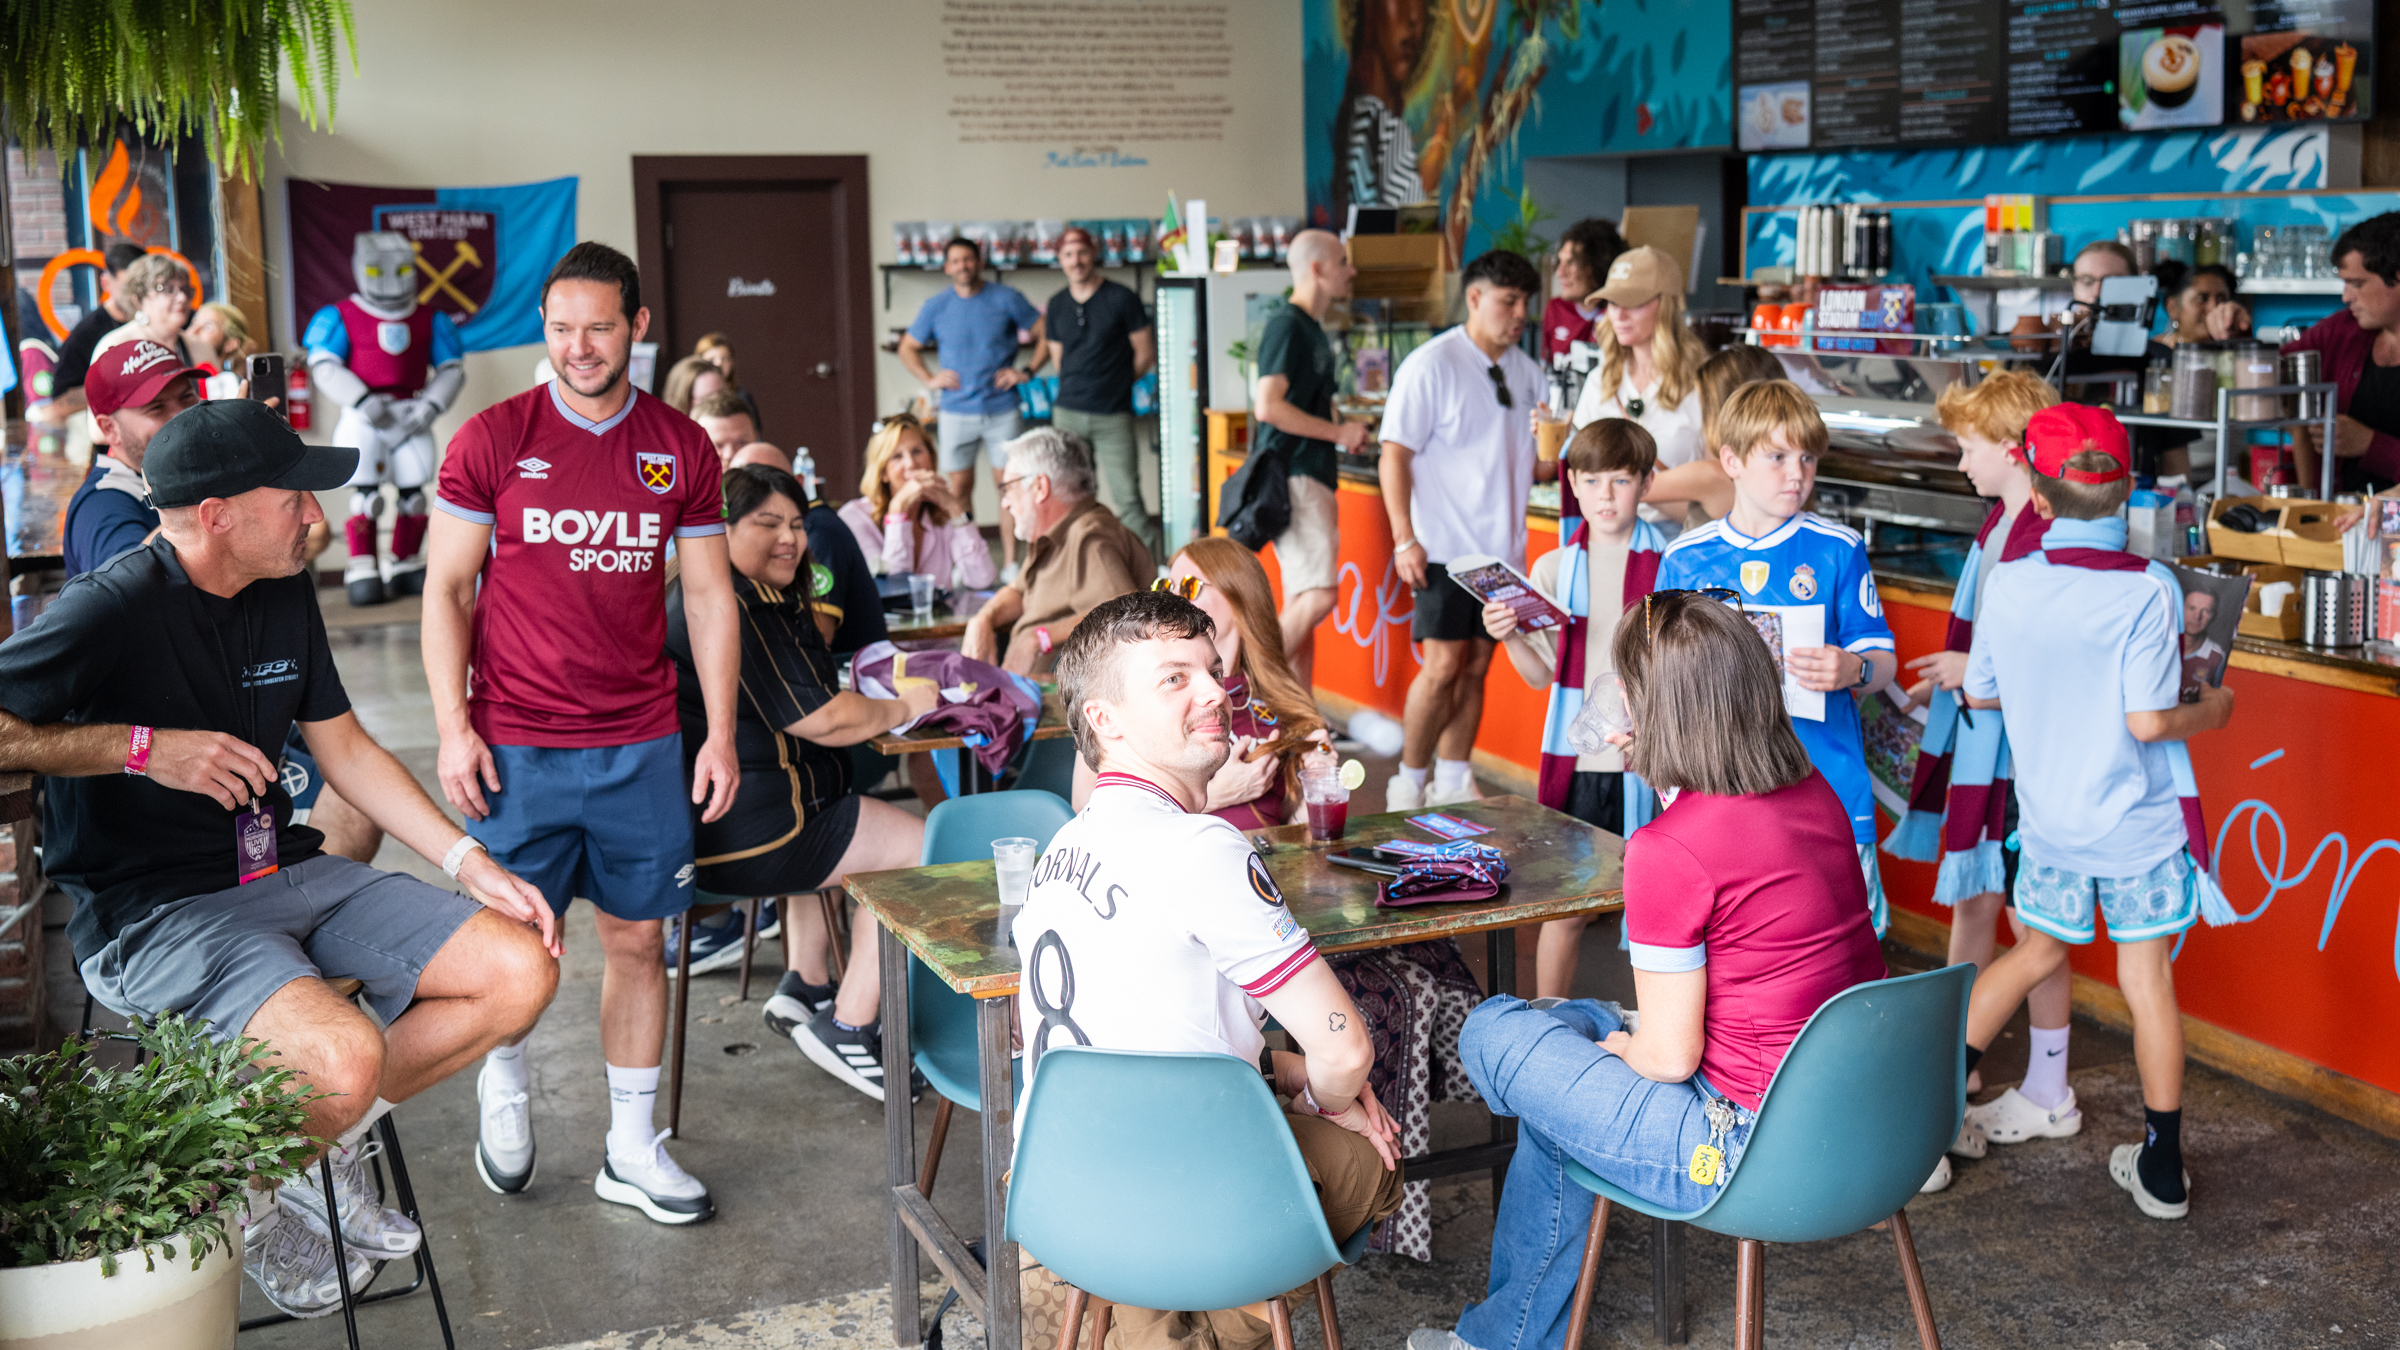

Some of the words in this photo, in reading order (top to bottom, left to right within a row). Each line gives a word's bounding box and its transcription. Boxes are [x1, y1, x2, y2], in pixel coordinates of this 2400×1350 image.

[388, 211, 437, 229] WEST
[440, 210, 488, 230] HAM
[1820, 290, 1867, 312] LONDON
[1818, 312, 1861, 329] STADIUM
[520, 471, 548, 480] umbro
[522, 507, 661, 548] BOYLE
[569, 548, 655, 573] SPORTS
[139, 726, 150, 750] GUEST
[251, 838, 263, 847] LIVE
[1029, 929, 1093, 1081] 8
